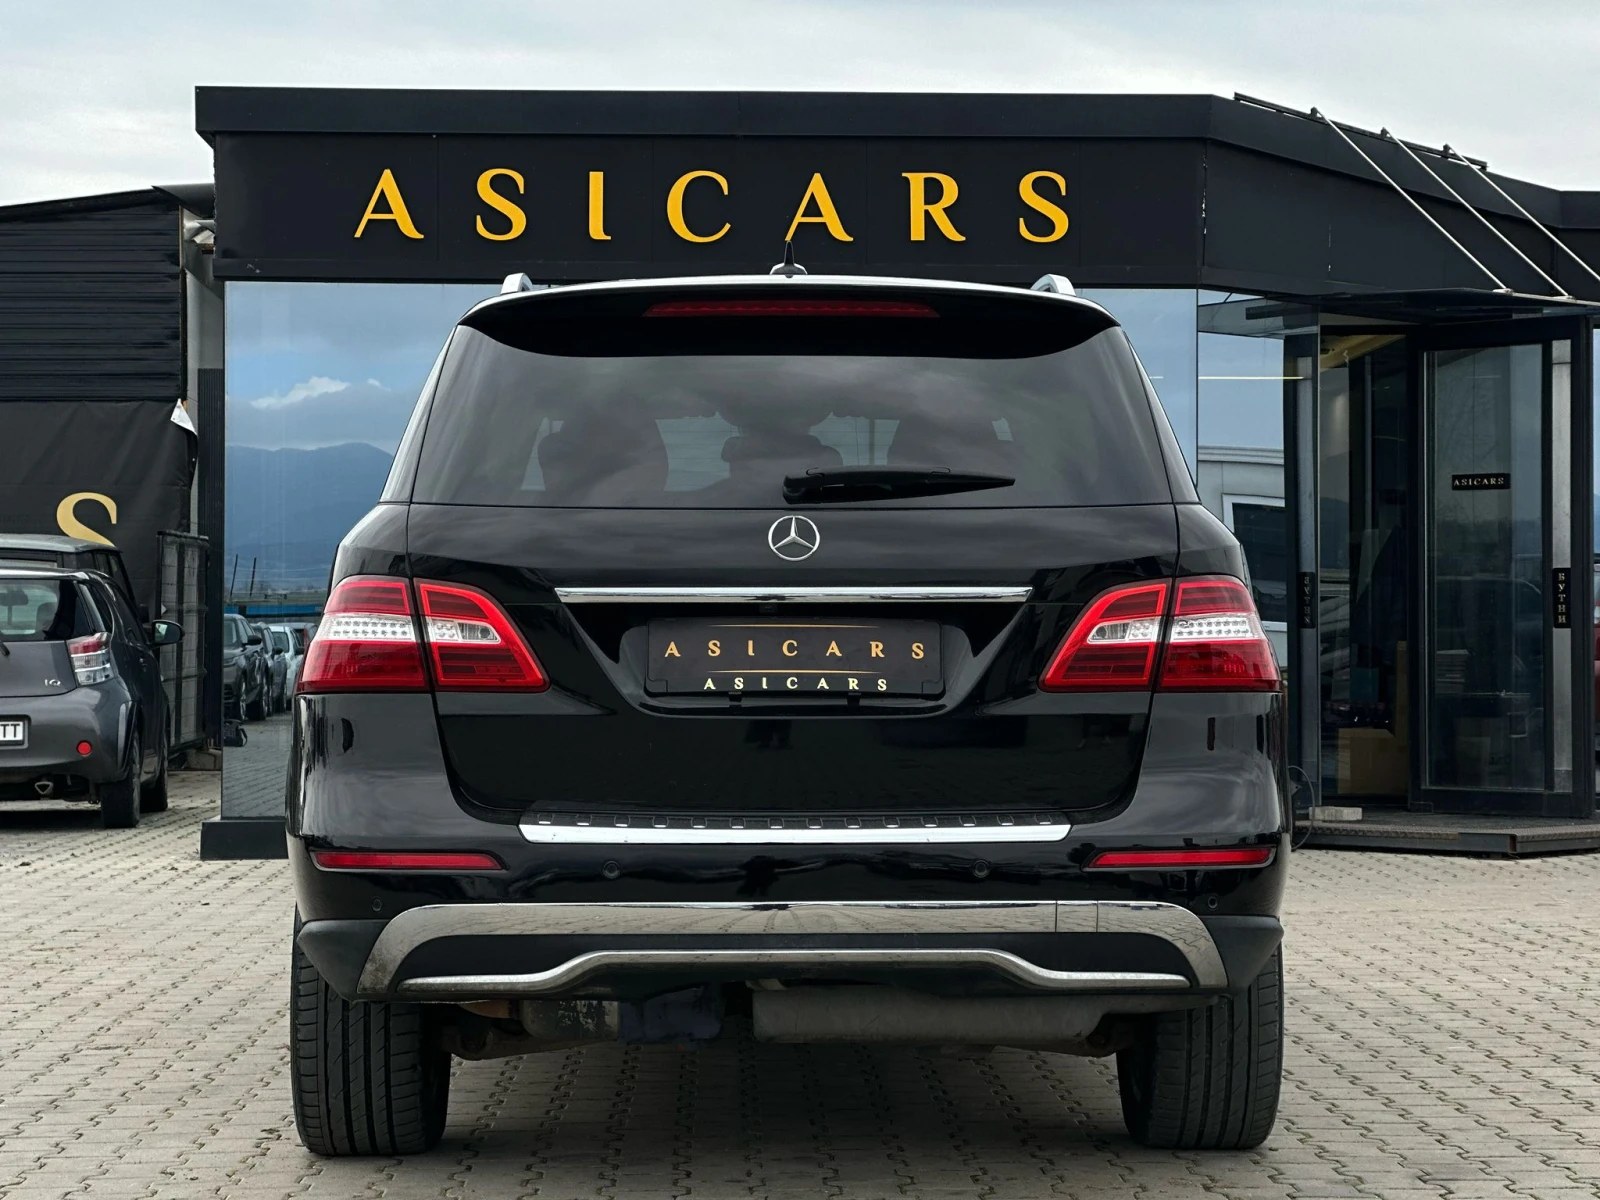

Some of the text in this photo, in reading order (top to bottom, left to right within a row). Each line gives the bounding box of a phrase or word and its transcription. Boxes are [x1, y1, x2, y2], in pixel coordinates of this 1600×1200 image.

[354, 168, 1070, 243] ASICARS
[1453, 477, 1504, 486] ASICARS
[664, 639, 925, 660] ASICARS
[703, 676, 888, 692] ASICARS
